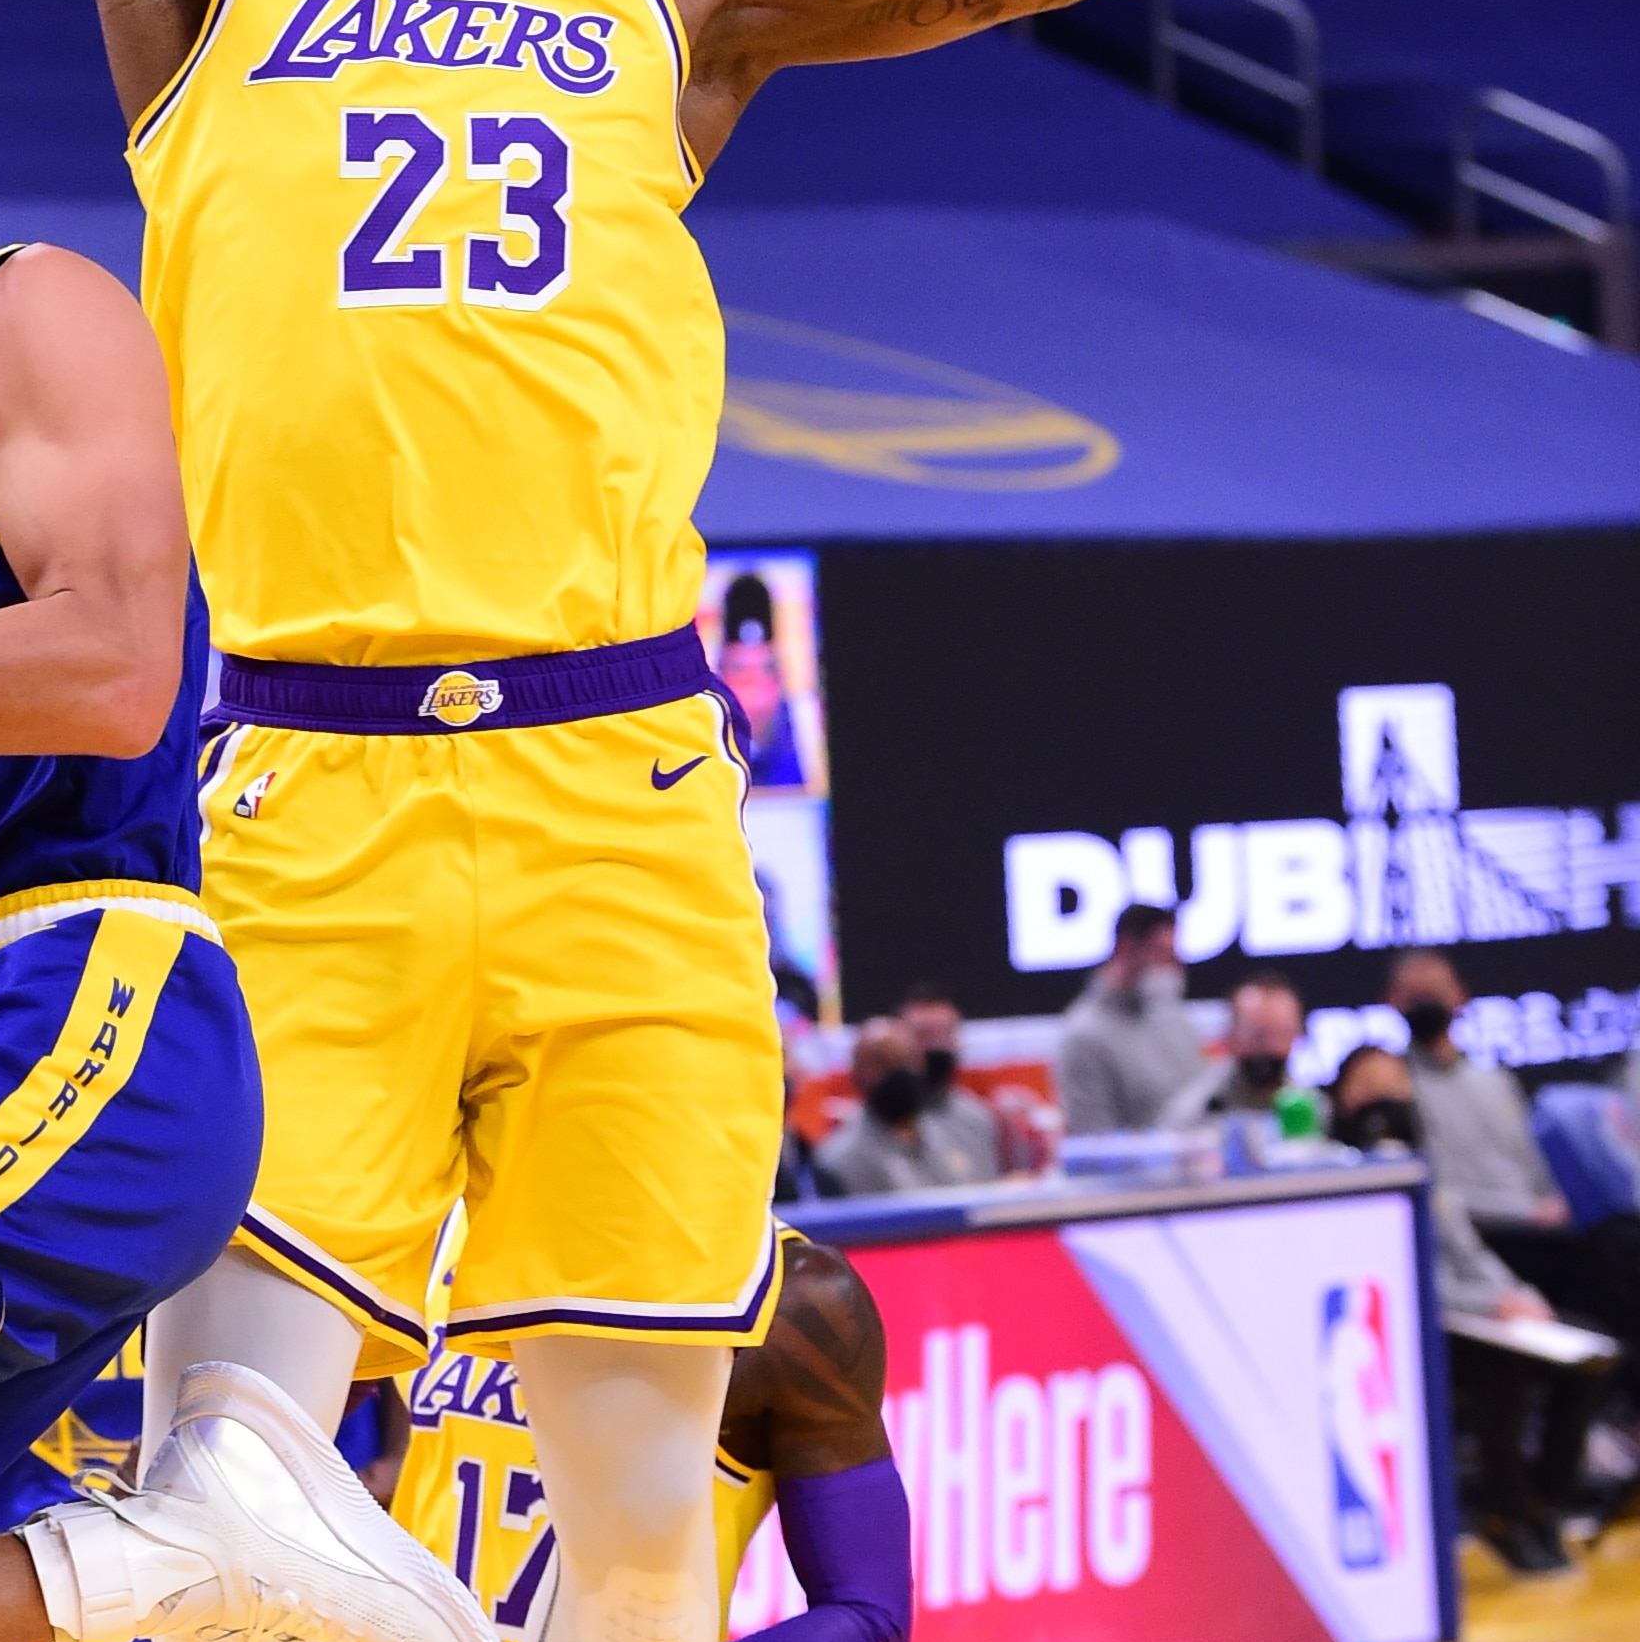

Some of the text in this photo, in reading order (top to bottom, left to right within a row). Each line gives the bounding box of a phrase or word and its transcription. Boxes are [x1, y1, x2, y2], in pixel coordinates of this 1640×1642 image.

[339, 107, 573, 312] 23
[425, 685, 497, 714] LAKERS
[452, 1452, 558, 1641] 17
